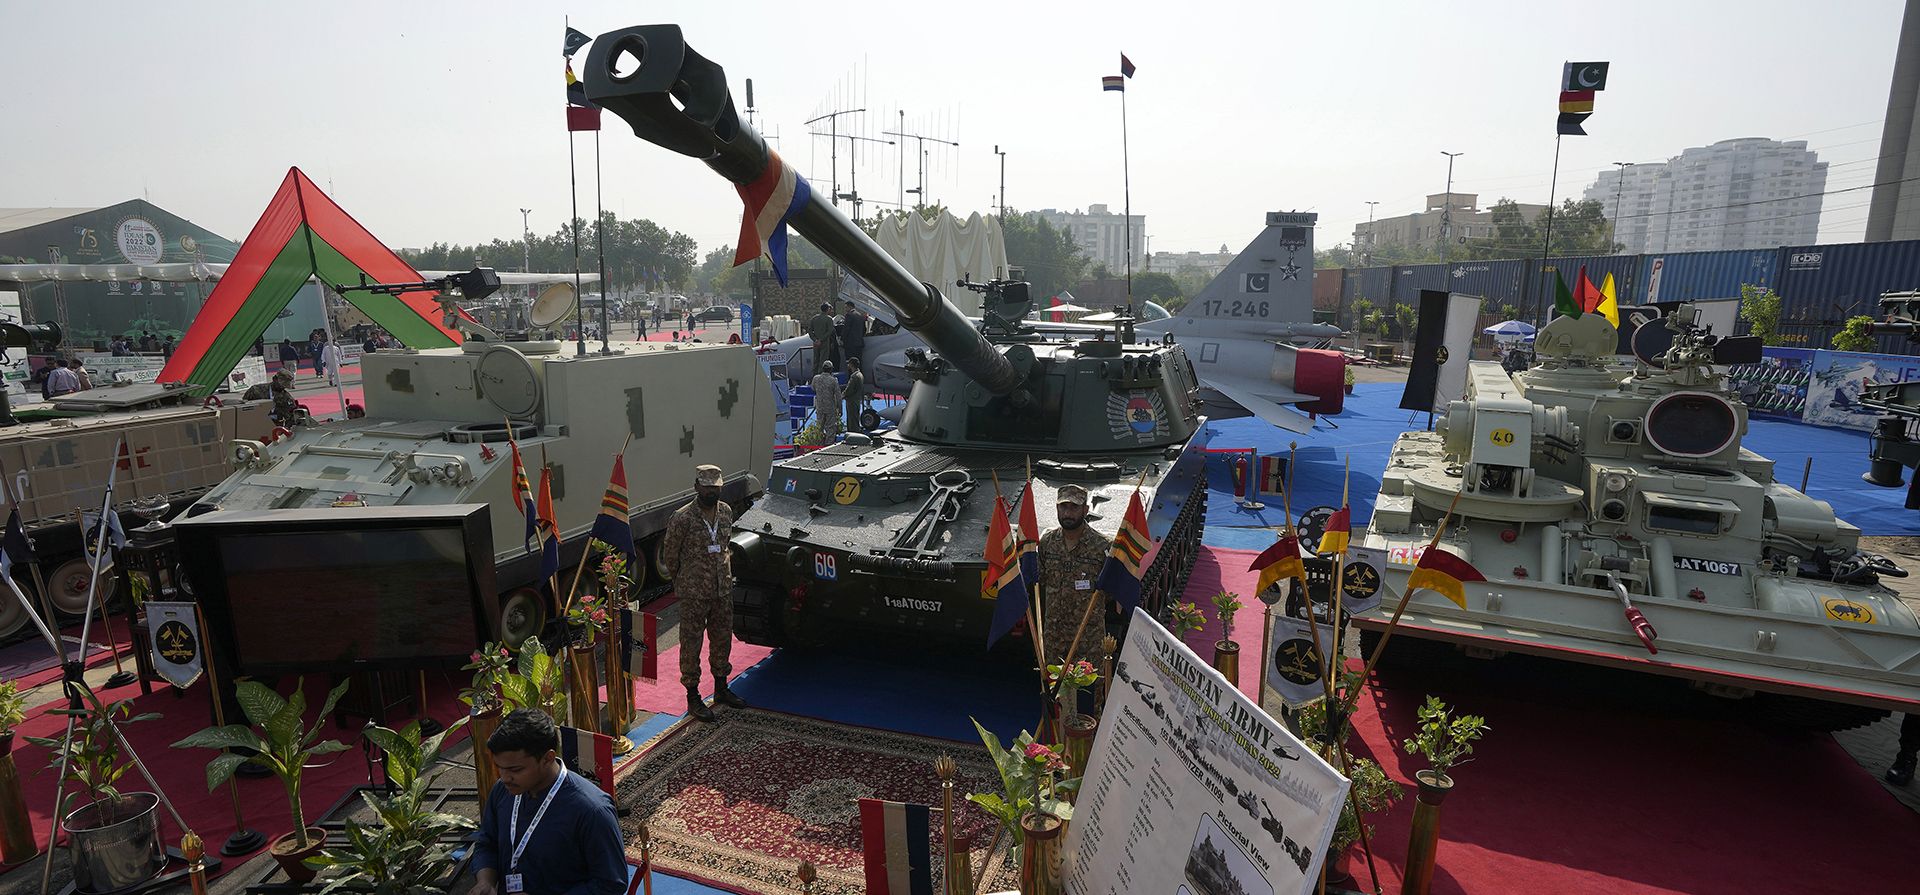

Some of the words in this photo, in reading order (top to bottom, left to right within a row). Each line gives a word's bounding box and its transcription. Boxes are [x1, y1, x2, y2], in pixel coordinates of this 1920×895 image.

[1202, 299, 1270, 318] 17-246
[1493, 431, 1515, 443] 40
[785, 479, 798, 493] F1
[836, 481, 859, 498] 27
[814, 552, 836, 578] 619
[1159, 641, 1224, 706] PAKISTAN
[1225, 699, 1274, 749] ARMY
[1122, 704, 1158, 745] Specifications
[1160, 726, 1169, 741] 155
[1175, 745, 1204, 780] HOWITZER
[1203, 776, 1225, 804] M109L
[1256, 752, 1282, 779] 2022
[1217, 809, 1250, 848] Pictorial
[1249, 843, 1271, 871] View
